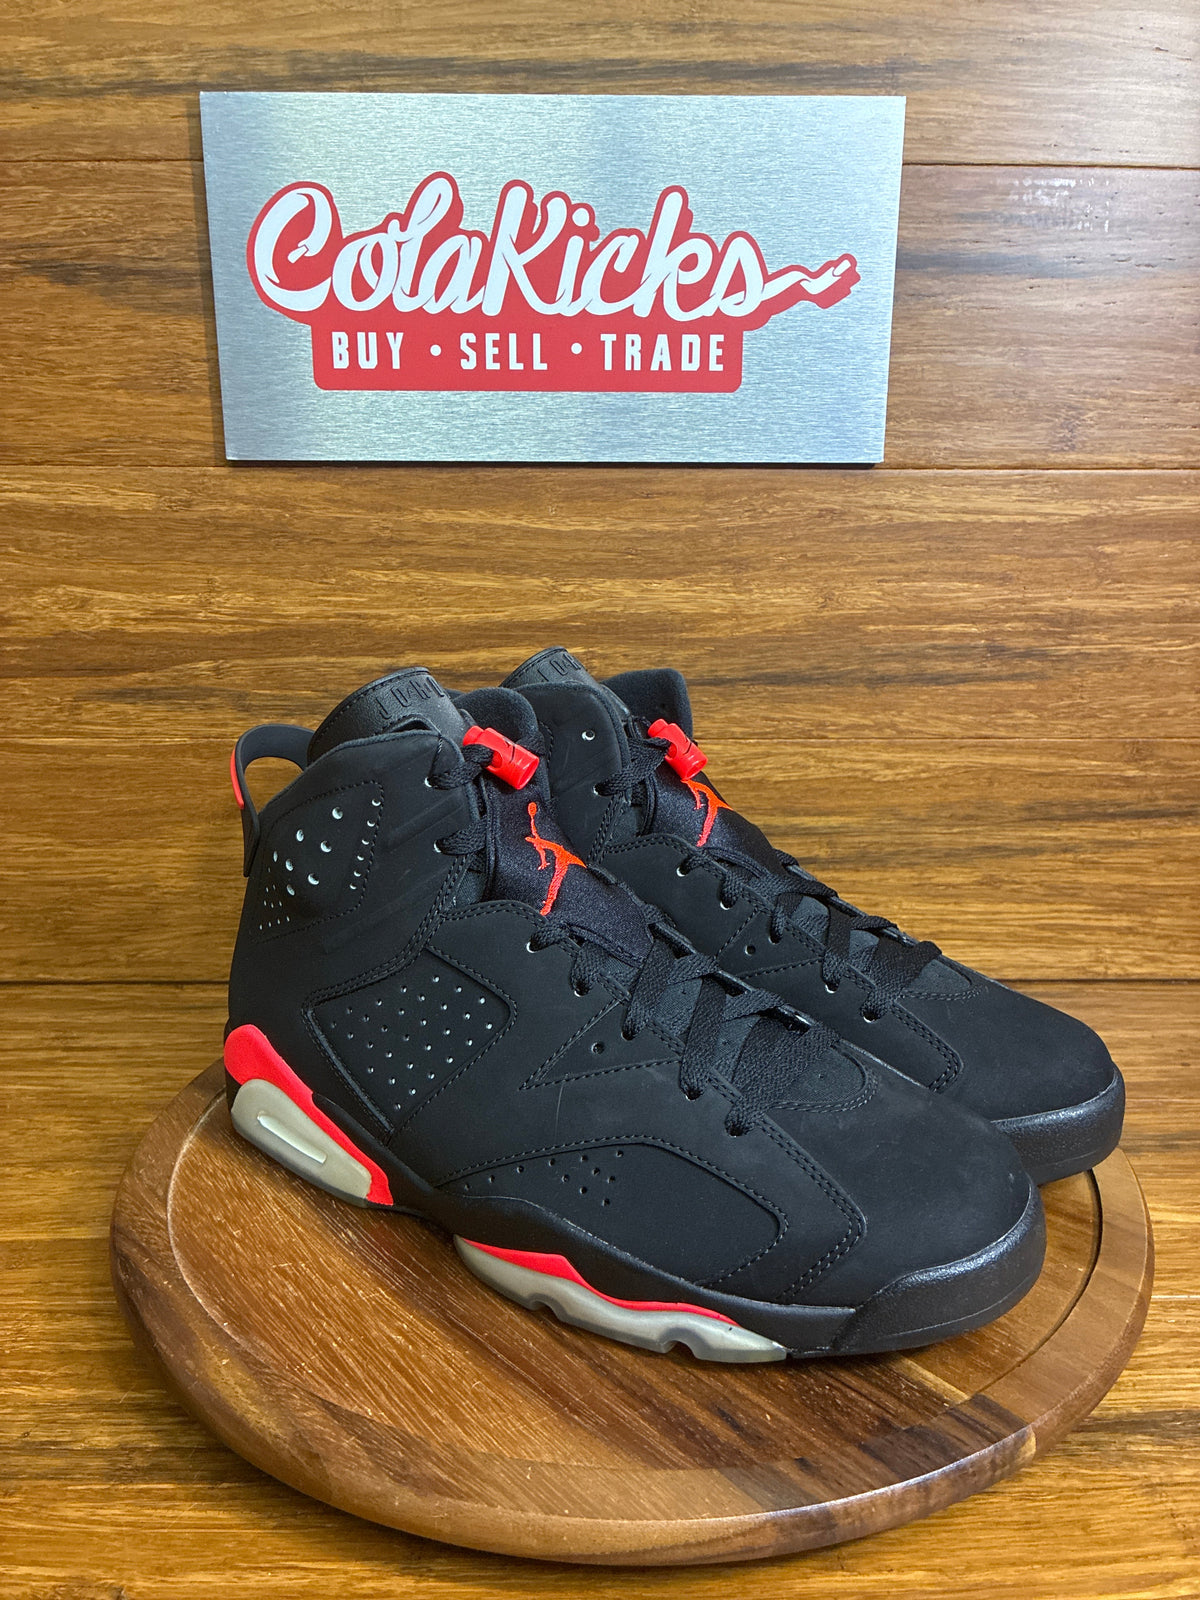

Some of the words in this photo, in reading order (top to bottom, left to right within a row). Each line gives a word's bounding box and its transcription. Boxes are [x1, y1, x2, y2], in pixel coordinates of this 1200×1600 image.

[253, 175, 854, 322] ColaKicks
[331, 331, 404, 370] BUY
[459, 332, 548, 371] SELL
[600, 333, 725, 372] TRADE
